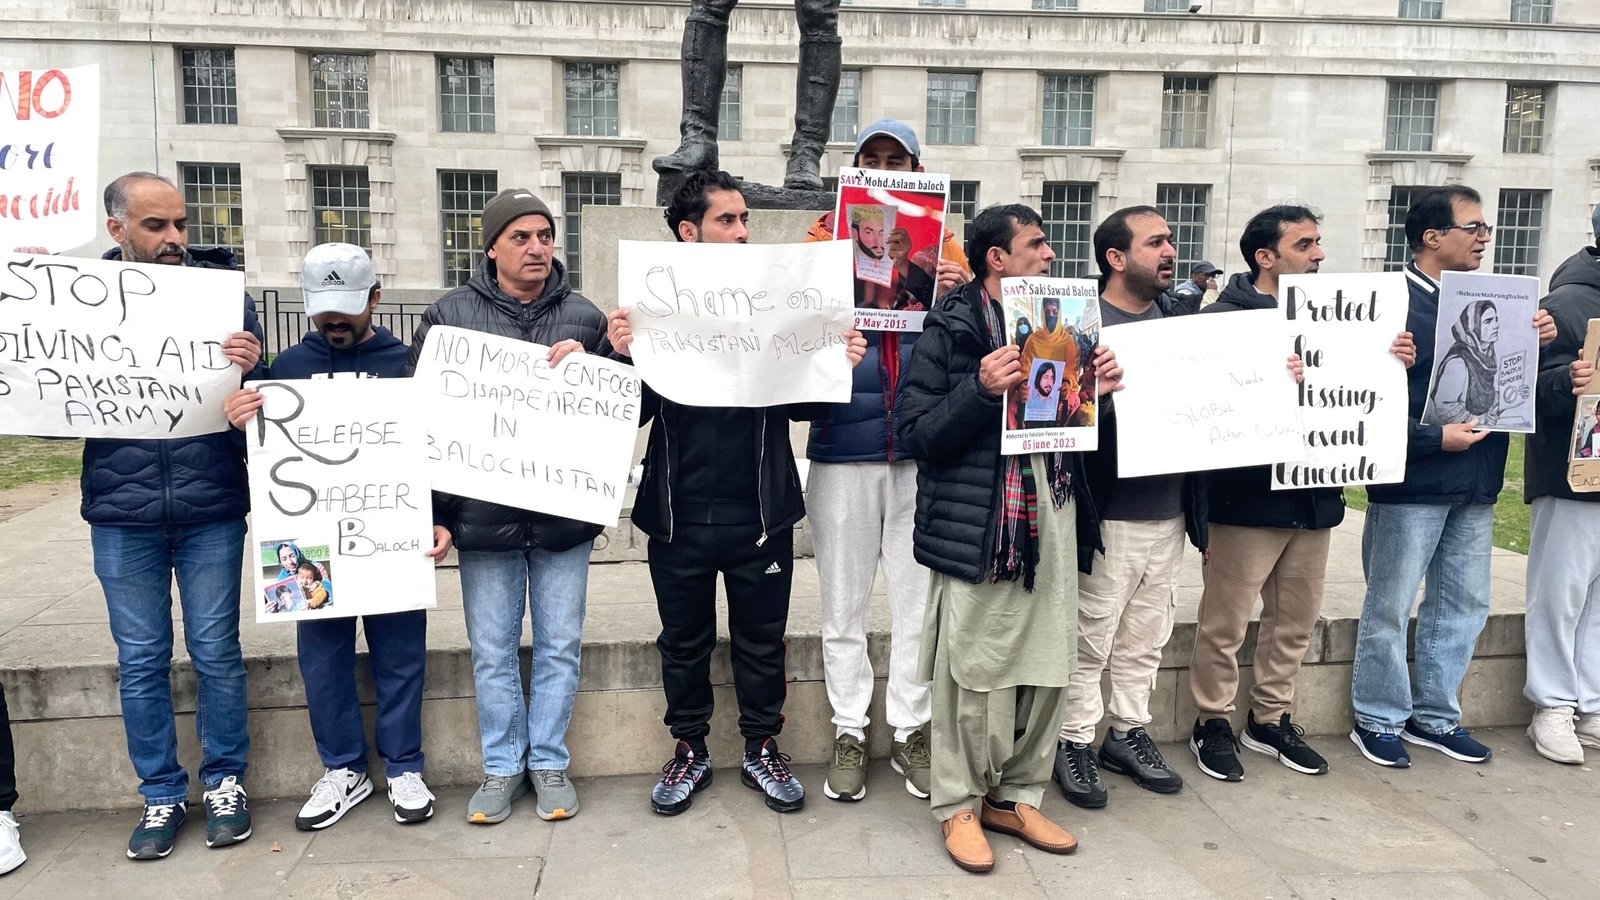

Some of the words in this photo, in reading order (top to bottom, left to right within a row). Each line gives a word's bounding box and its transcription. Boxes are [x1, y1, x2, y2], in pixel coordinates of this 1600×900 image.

[0, 70, 72, 121] NO
[0, 142, 56, 170] ore
[840, 174, 863, 186] SAVE
[918, 179, 945, 191] baloch
[0, 257, 157, 327] STOP
[321, 279, 345, 287] adidas
[636, 266, 775, 319] Shame
[786, 287, 823, 311] on
[1003, 285, 1028, 296] SAVE
[1029, 283, 1046, 295] Saki
[1047, 284, 1071, 296] Sawad
[1072, 285, 1097, 297] Baloch
[1286, 285, 1382, 322] Protect
[772, 322, 846, 360] Media
[863, 317, 881, 329] May
[884, 319, 907, 329] 2015
[156, 336, 233, 373] AID
[435, 332, 470, 365] NO
[479, 342, 551, 381] MORE
[563, 361, 641, 398] ENFOCED
[1290, 334, 1324, 368] he
[1503, 355, 1523, 369] STOP
[35, 367, 203, 404] PAKISTANI
[440, 369, 636, 421] DISAPPEARENCE
[64, 399, 184, 433] ARMY
[256, 382, 401, 466] RELEASE
[493, 412, 517, 438] IN
[1303, 420, 1369, 447] event
[1022, 439, 1032, 451] 05
[1033, 439, 1051, 451] june
[1053, 437, 1076, 449] 2023
[426, 434, 616, 500] BALOCHISTAN
[1275, 455, 1381, 487] Genocide
[268, 455, 418, 517] SHABEER
[338, 517, 420, 558] BALOCH
